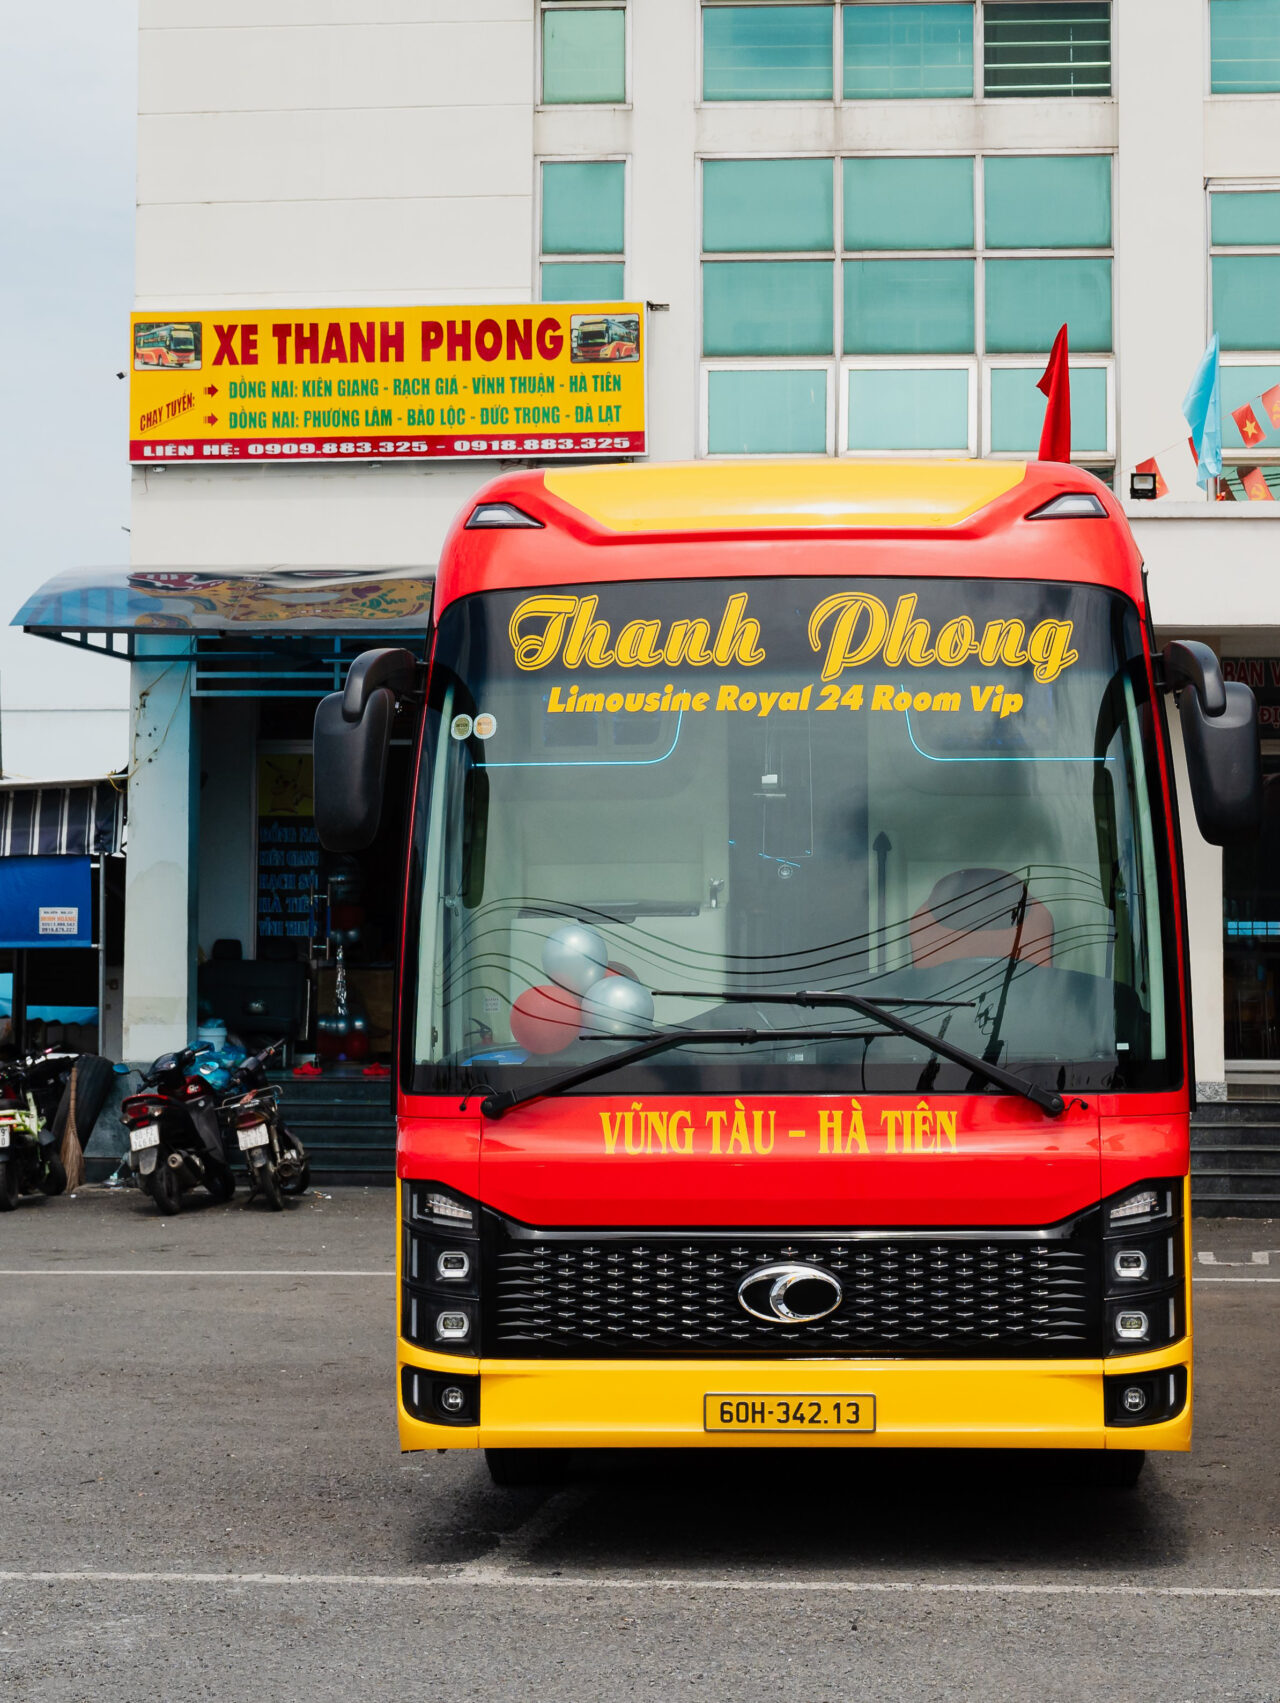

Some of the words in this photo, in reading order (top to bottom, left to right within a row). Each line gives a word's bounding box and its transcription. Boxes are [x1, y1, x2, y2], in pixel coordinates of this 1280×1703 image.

[212, 324, 258, 366] XE
[272, 321, 405, 365] THANH
[421, 317, 564, 362] PHONG
[229, 375, 266, 399] ĐỒNG
[271, 380, 299, 398] NAI:
[302, 376, 332, 397] KIÊN
[337, 378, 379, 397] GIANG
[393, 378, 430, 399] RẠCH
[435, 374, 458, 395] GIÁ
[472, 375, 505, 395] VĨNH
[510, 372, 555, 397] THUẬN
[569, 372, 587, 393] HÀ
[592, 372, 621, 393] TIÊN
[229, 406, 267, 429] ĐỒNG
[272, 410, 299, 428] NAI:
[303, 407, 360, 428] PHƯƠNG
[364, 406, 392, 427] LÂM
[440, 405, 466, 429] LỘC
[480, 404, 509, 425] ĐỨC
[514, 406, 560, 428] TRỌNG
[575, 403, 593, 423] ĐÀ
[598, 405, 622, 426] LẠT
[143, 443, 194, 457] LIÊN
[203, 443, 240, 458] HỆ:
[247, 440, 429, 456] 0909.883.325
[453, 436, 631, 452] 0918.883.325
[508, 592, 766, 671] Thanh
[807, 591, 1079, 684] Phong
[547, 685, 711, 714] Limousine
[715, 684, 813, 717] Royal
[815, 684, 864, 712] 24
[871, 684, 959, 712] Room
[970, 684, 1024, 719] Vip
[599, 1101, 695, 1155] VŨNG
[705, 1098, 776, 1155] TÀU
[817, 1098, 871, 1155] HÀ
[880, 1100, 958, 1155] TIÊN
[719, 1401, 861, 1424] 60H-342.13
